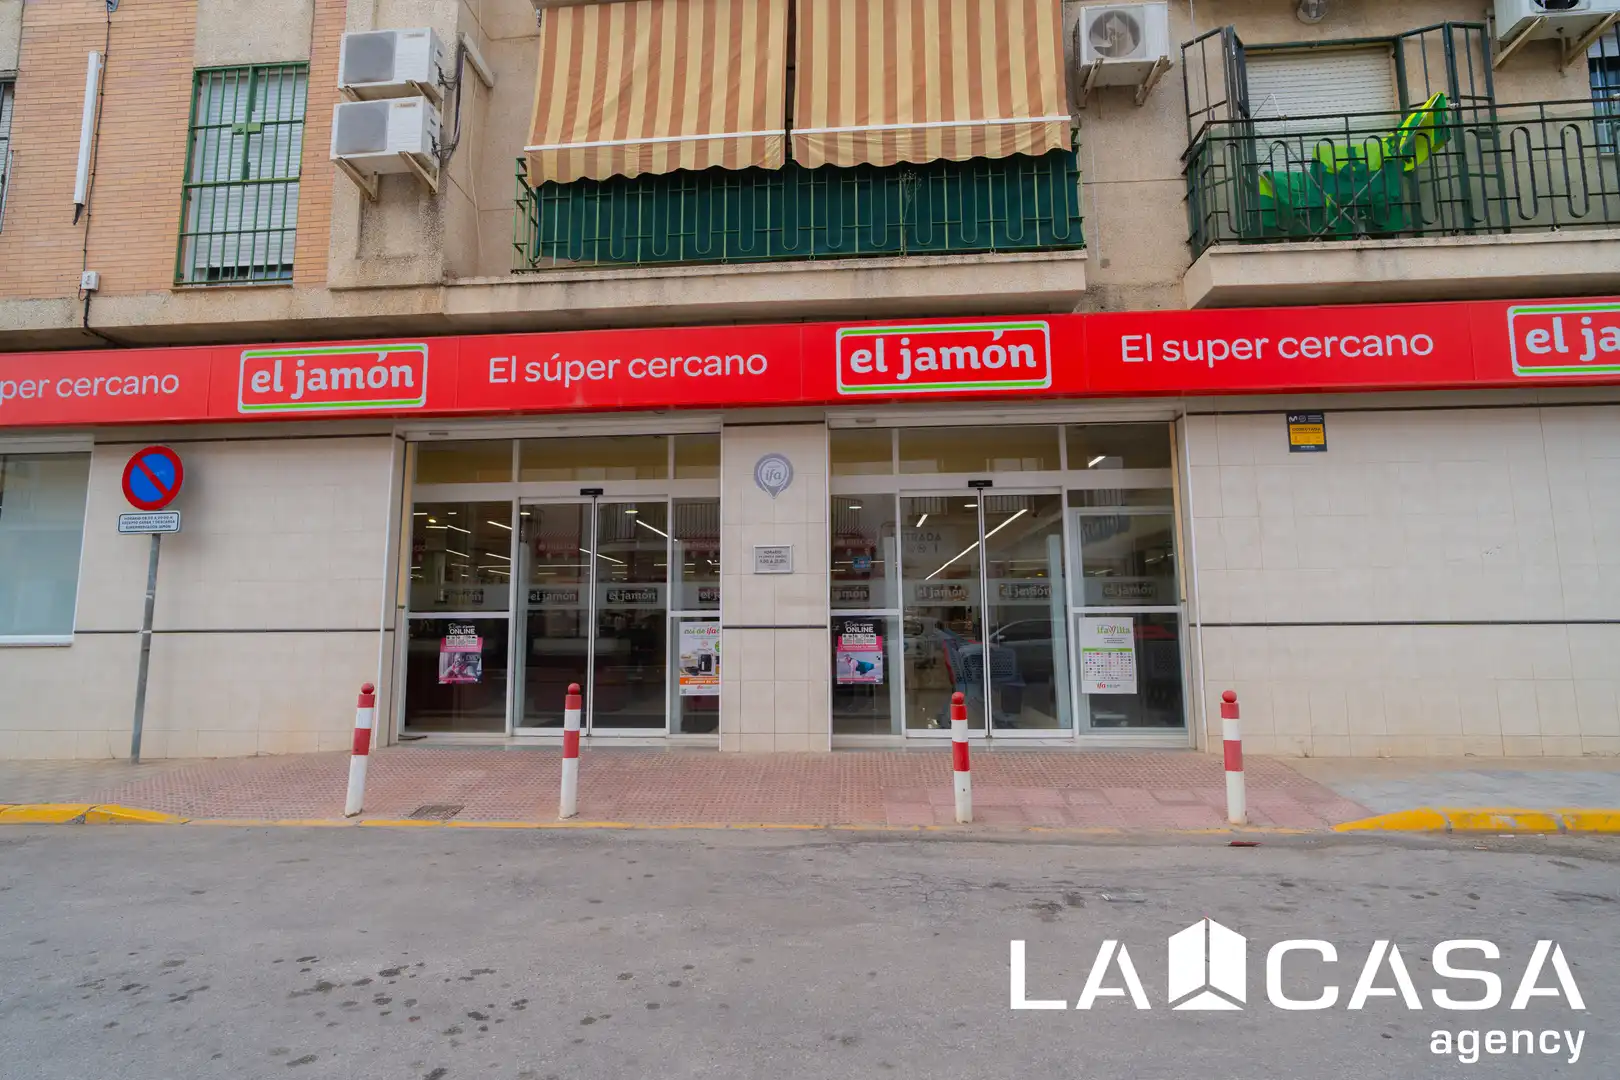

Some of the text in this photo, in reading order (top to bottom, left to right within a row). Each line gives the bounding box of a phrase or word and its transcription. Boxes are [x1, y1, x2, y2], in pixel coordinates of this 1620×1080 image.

[1121, 334, 1434, 368] El super cercano
[1525, 316, 1569, 354] el
[489, 354, 768, 388] El súper cercano
[850, 331, 1037, 381] el jamón
[56, 374, 180, 398] cercano
[251, 351, 414, 400] el jamón
[766, 468, 782, 482] ifa
